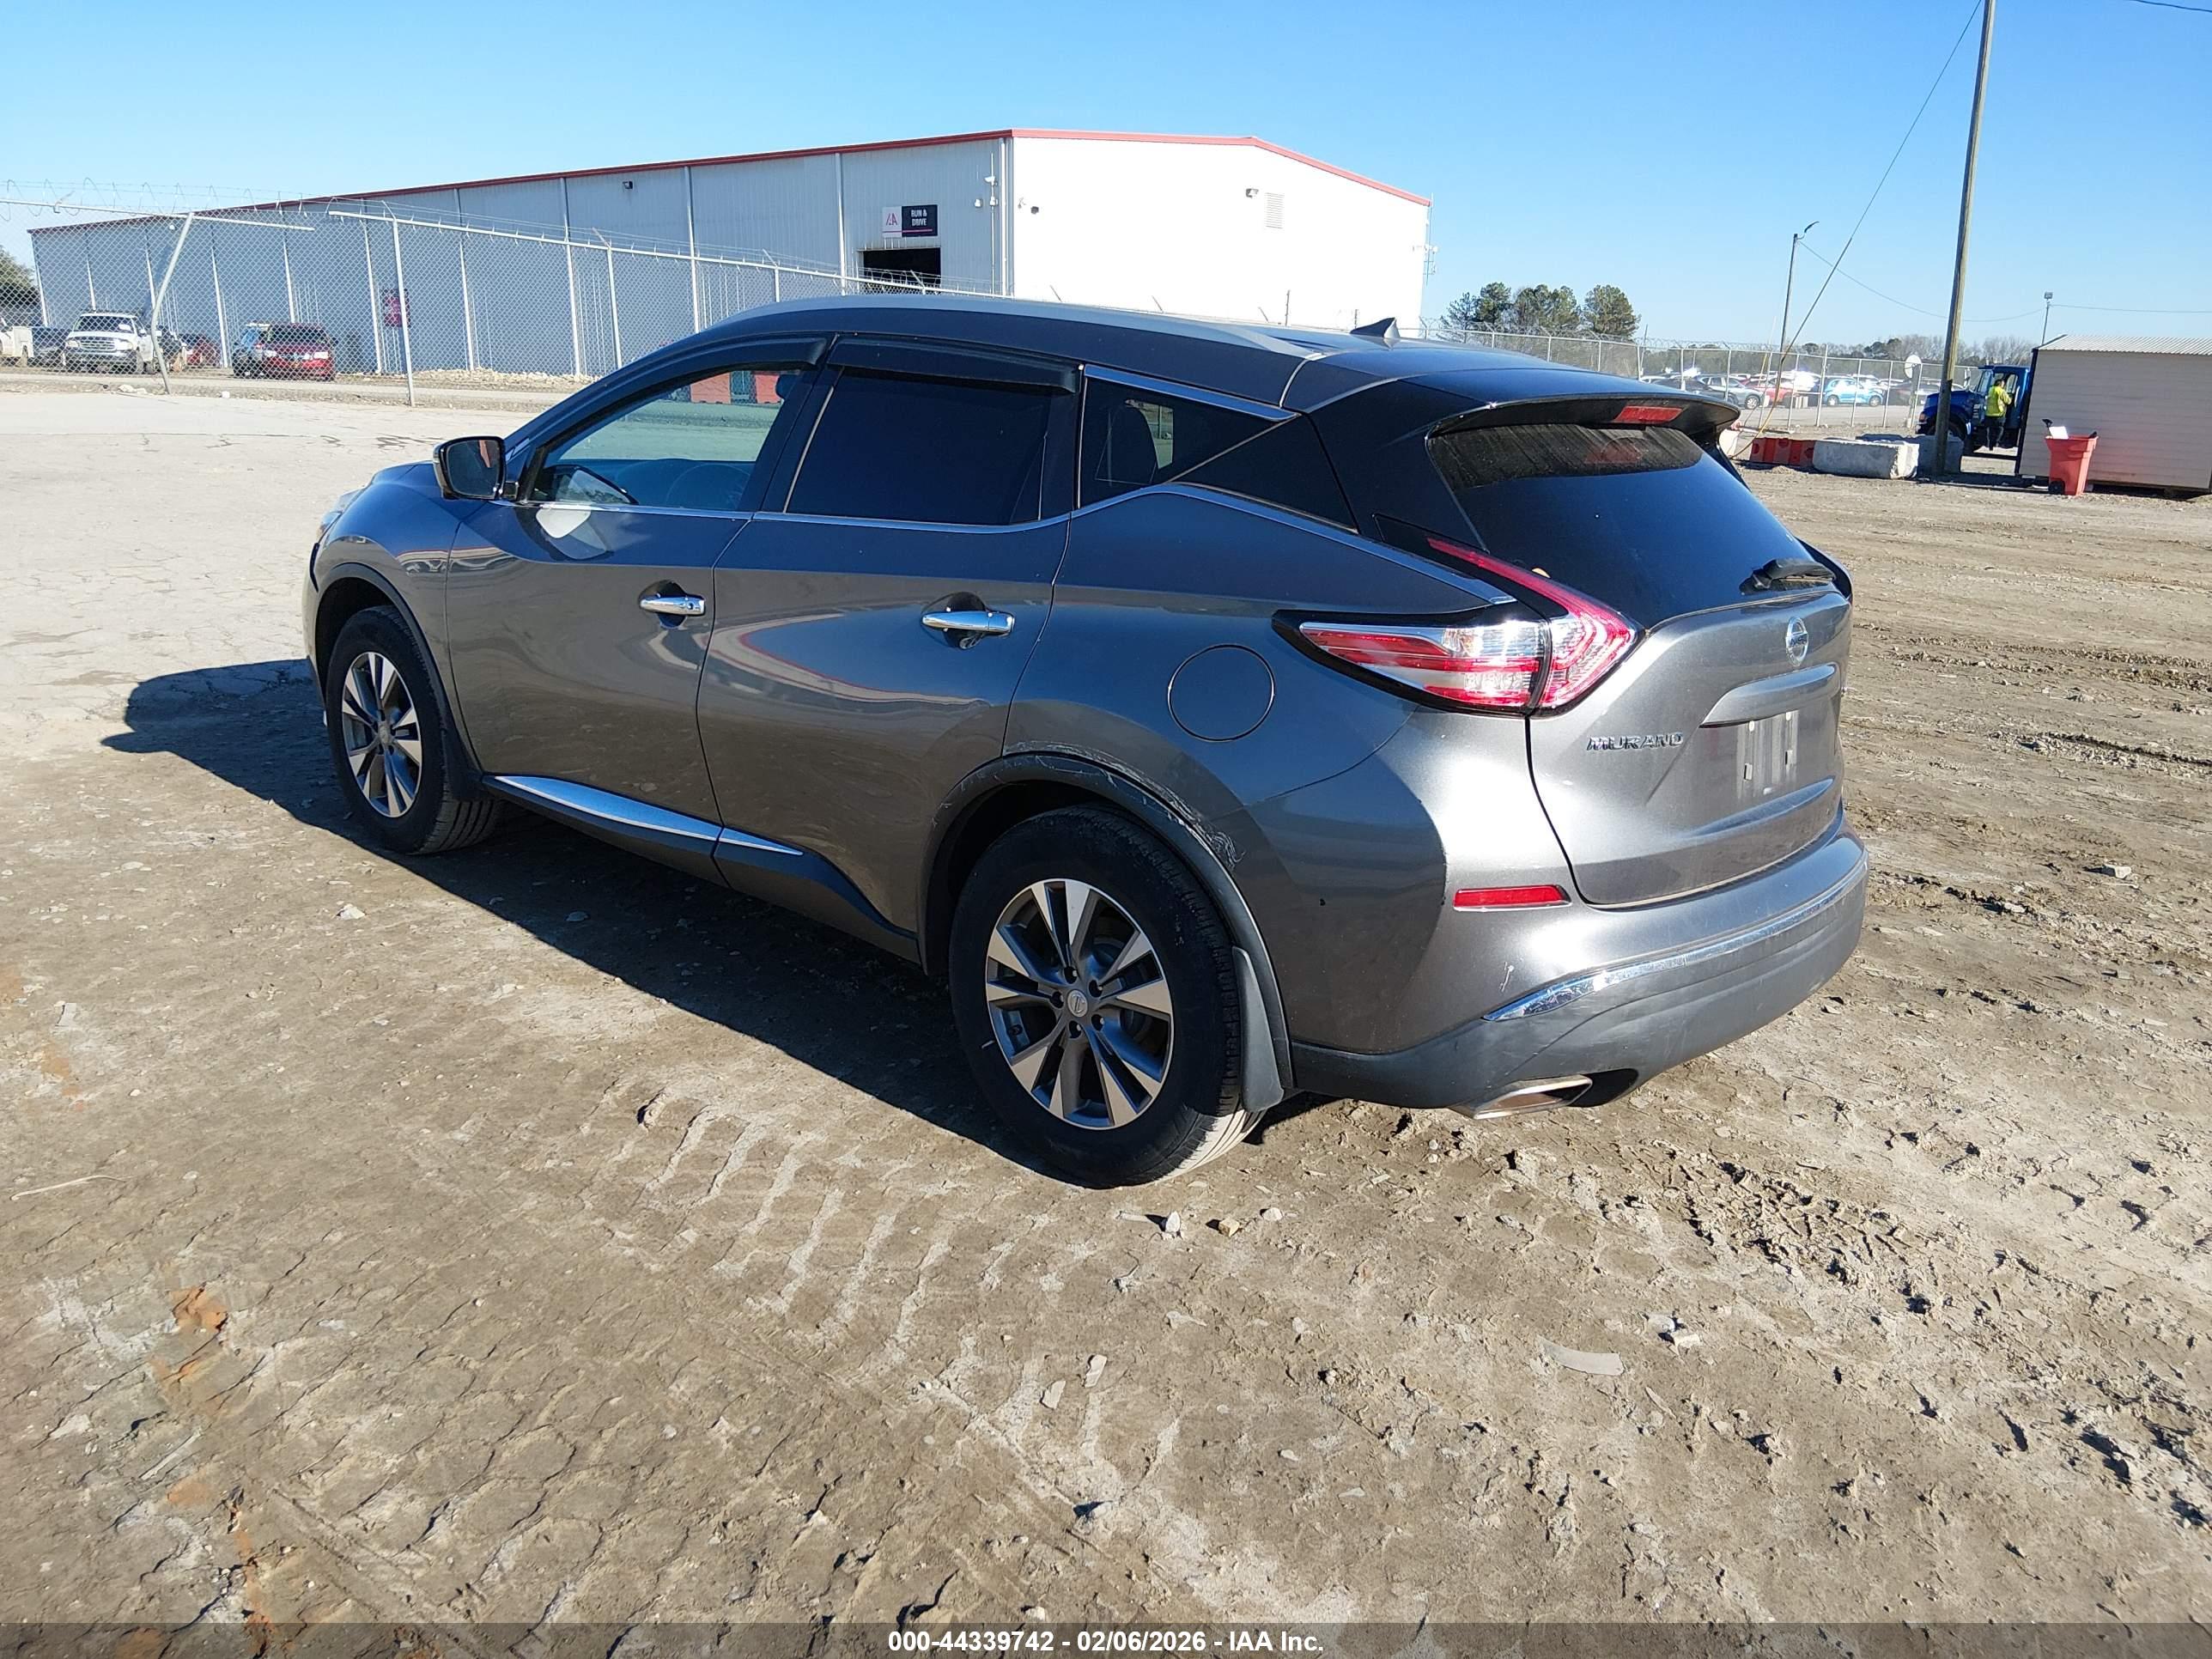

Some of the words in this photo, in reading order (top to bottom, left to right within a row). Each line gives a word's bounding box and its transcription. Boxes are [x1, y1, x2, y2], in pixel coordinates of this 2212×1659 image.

[910, 209, 922, 218] RUN
[922, 209, 927, 217] &
[911, 218, 927, 227] DRIVE
[1586, 732, 1684, 751] MURANO
